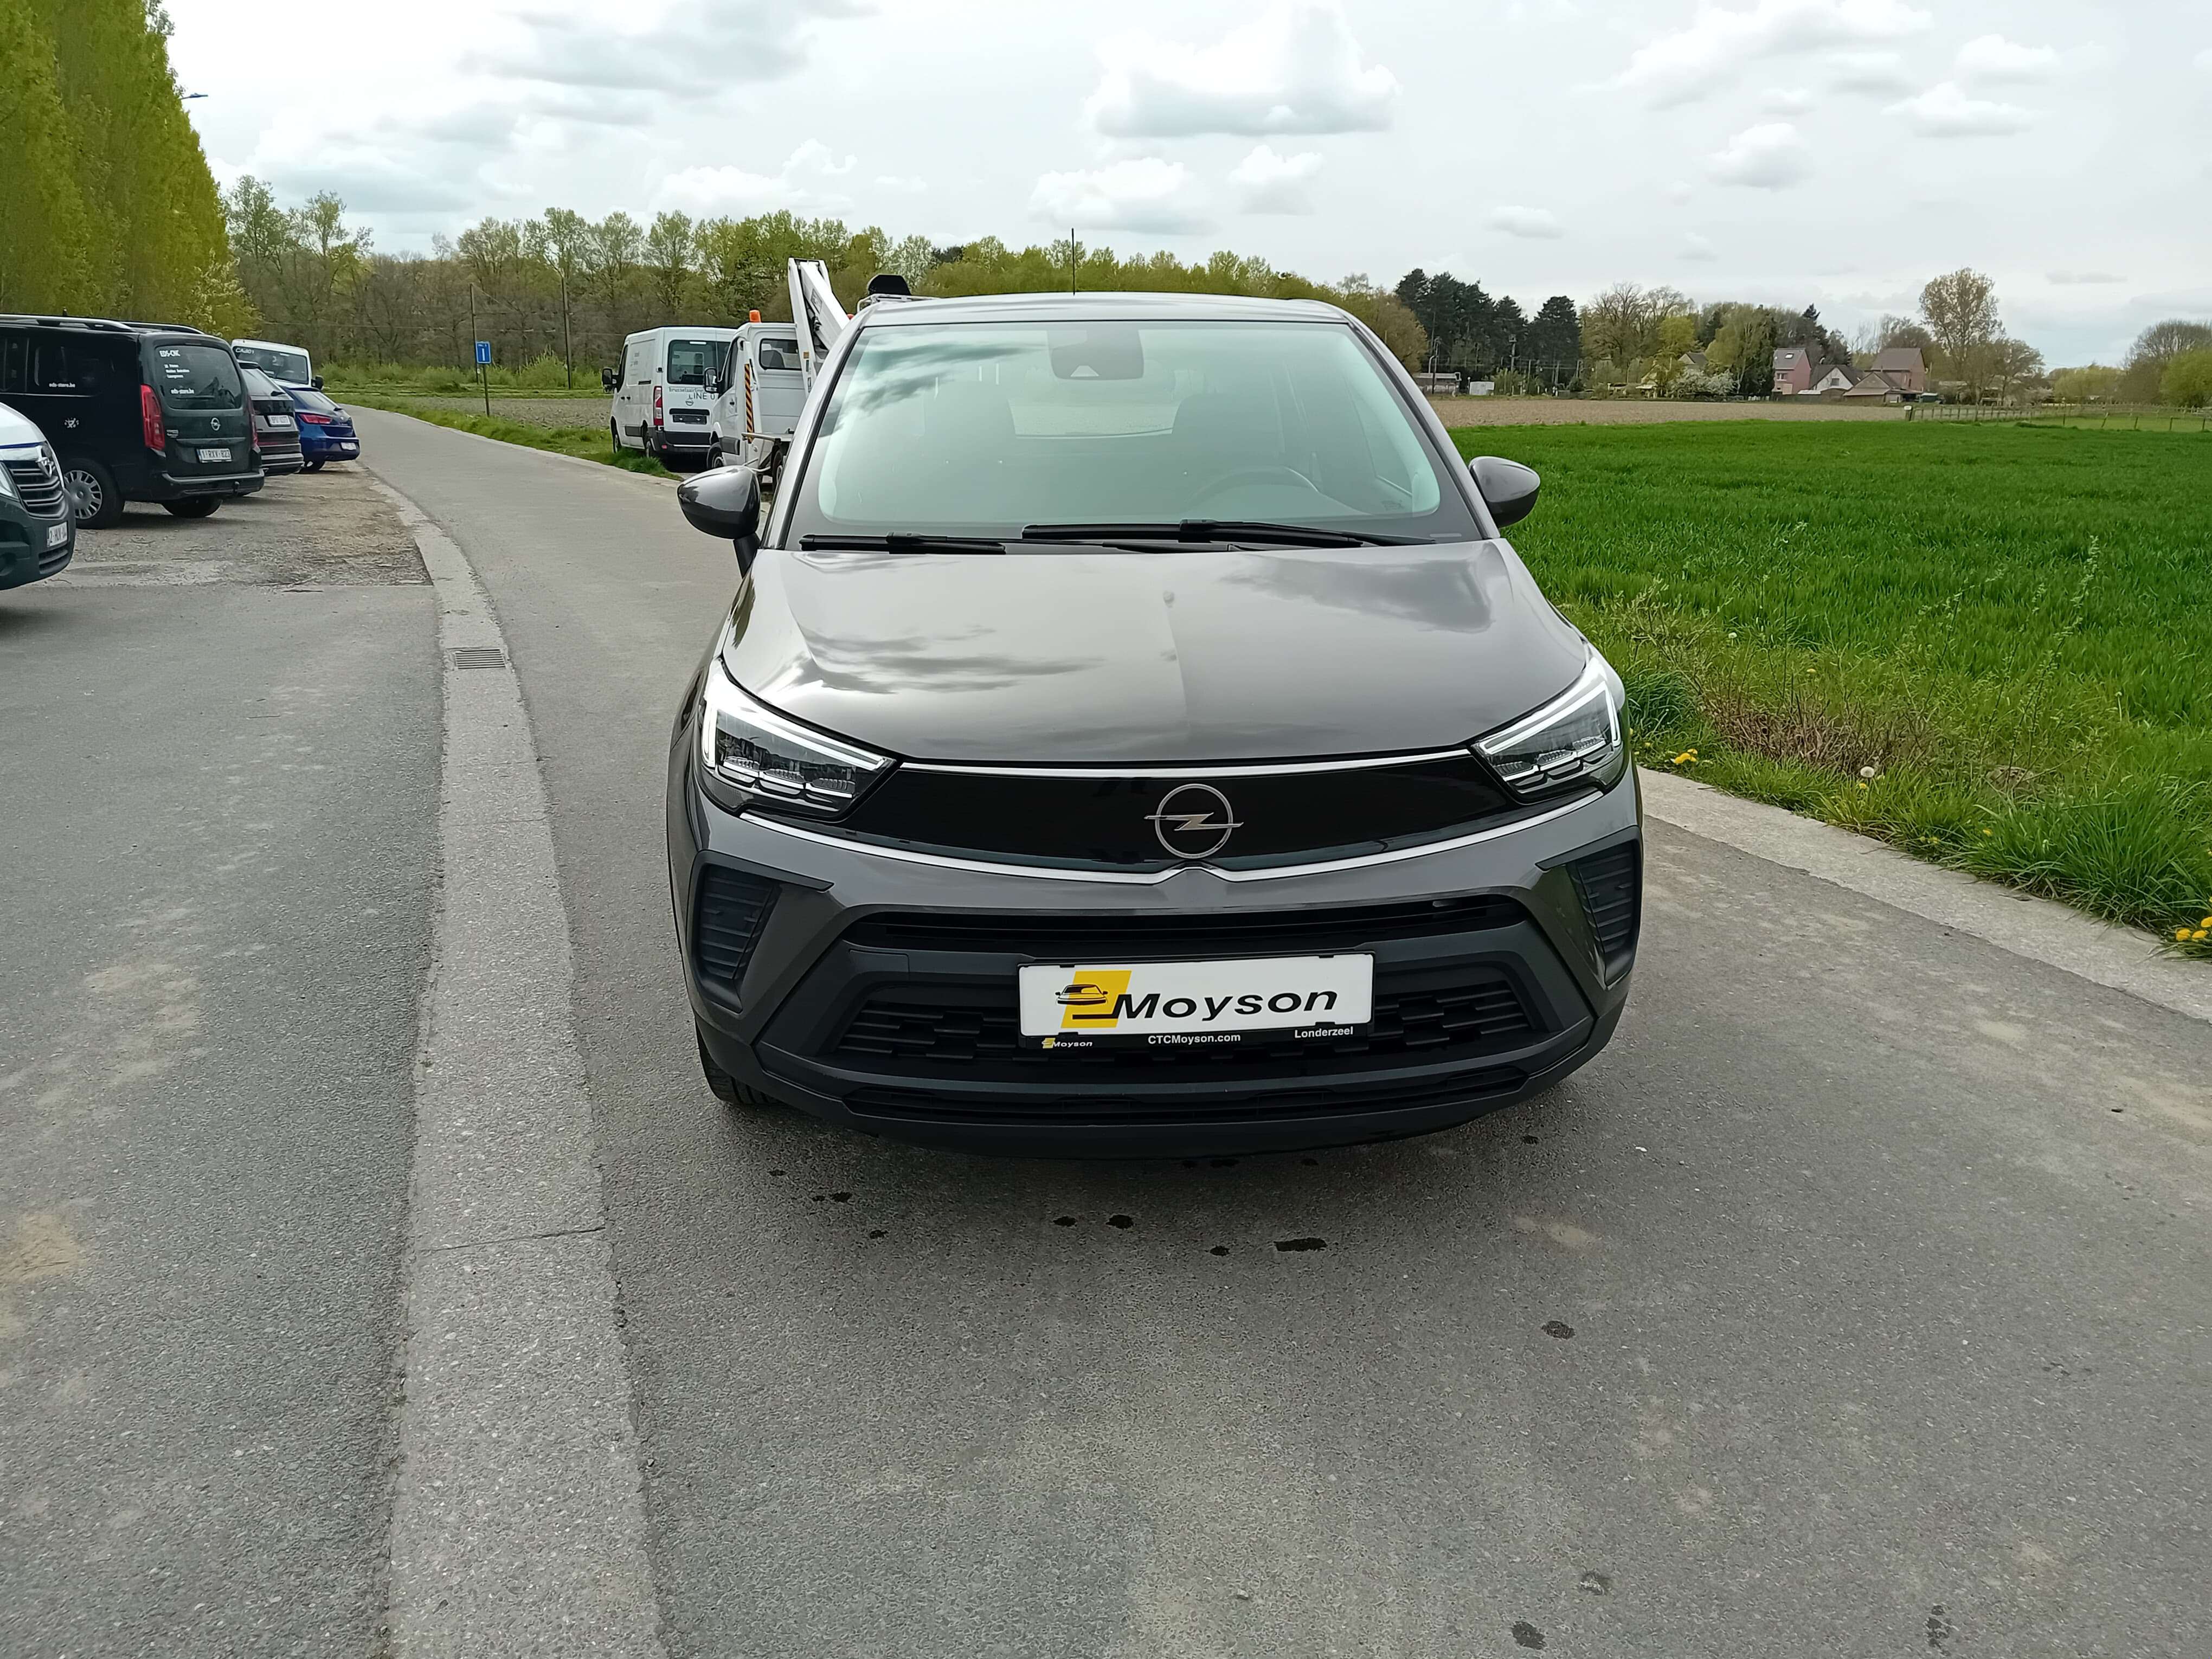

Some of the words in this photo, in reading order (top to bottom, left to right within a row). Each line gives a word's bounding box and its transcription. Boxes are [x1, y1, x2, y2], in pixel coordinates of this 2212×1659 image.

[1111, 991, 1338, 1021] Moyson
[1294, 1026, 1354, 1038] Londerzeel
[1148, 1033, 1241, 1045] CTCMoyson.com
